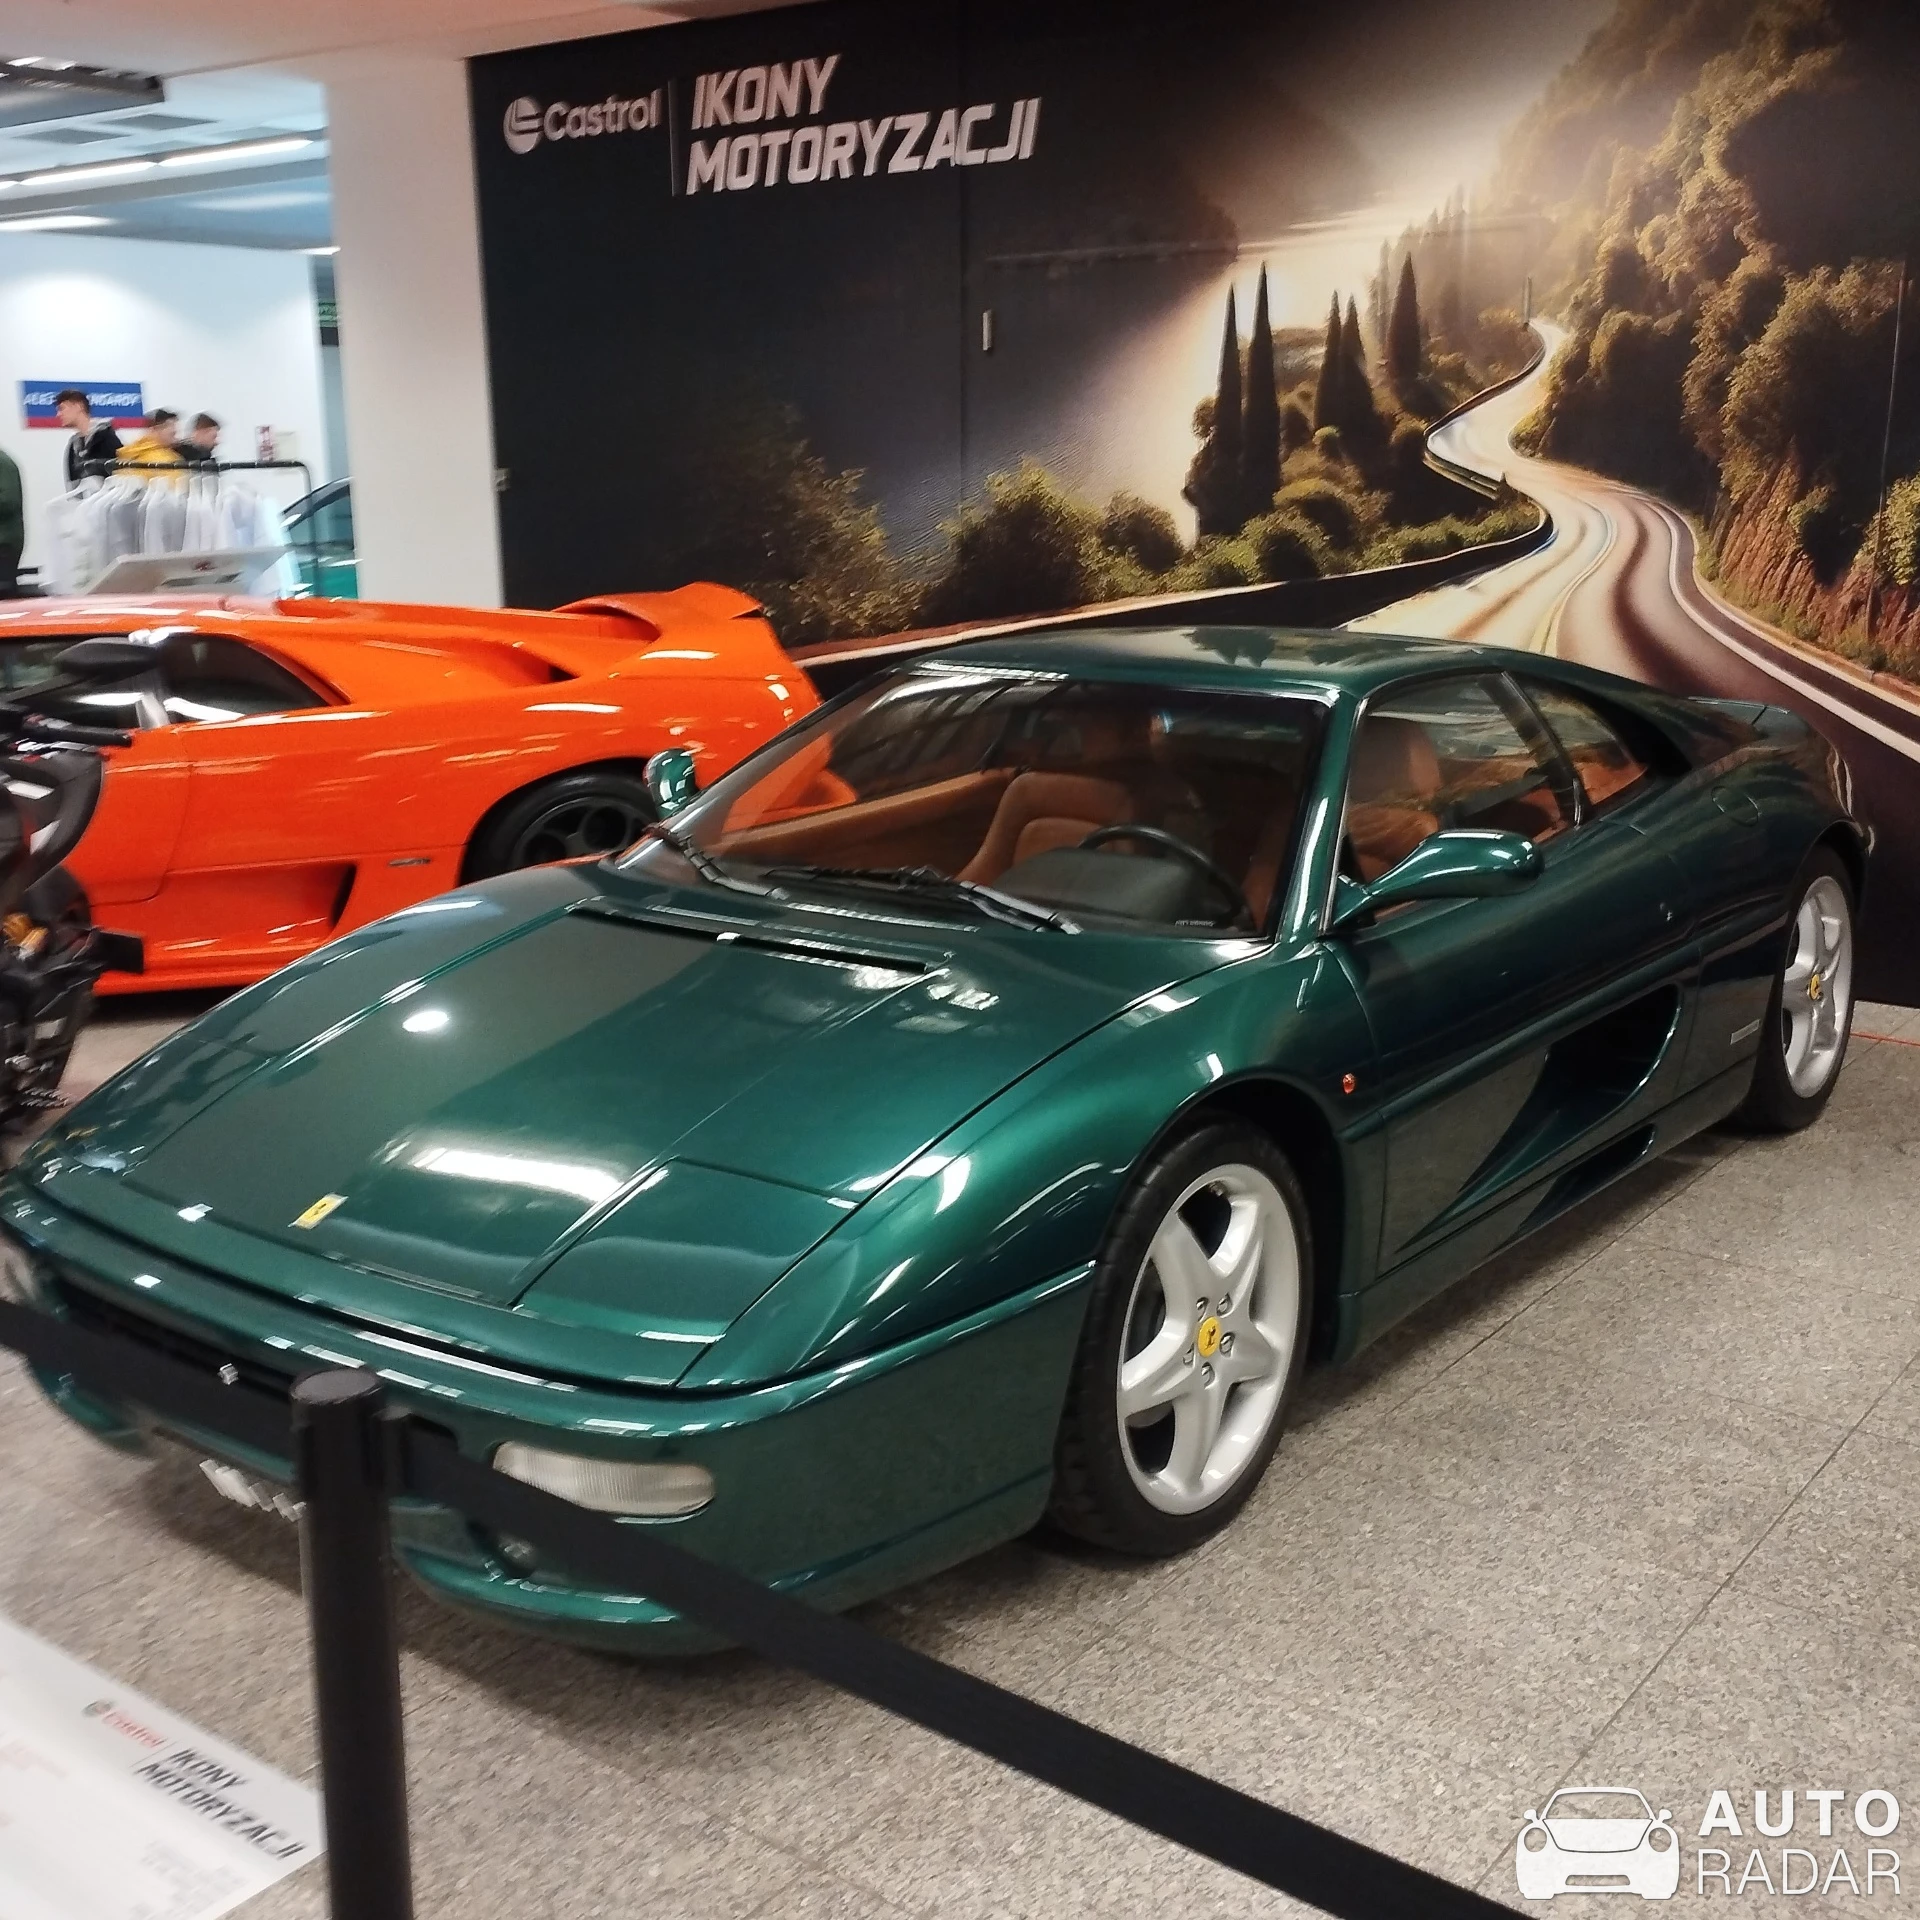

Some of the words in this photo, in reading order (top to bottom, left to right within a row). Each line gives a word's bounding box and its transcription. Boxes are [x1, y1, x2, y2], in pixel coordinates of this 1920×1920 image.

[543, 88, 662, 141] Castrol
[690, 53, 842, 130] IKONY
[685, 96, 1042, 196] MOTORYZACJI
[163, 1748, 250, 1790] IKONY
[132, 1762, 309, 1861] MOTORYZACJI
